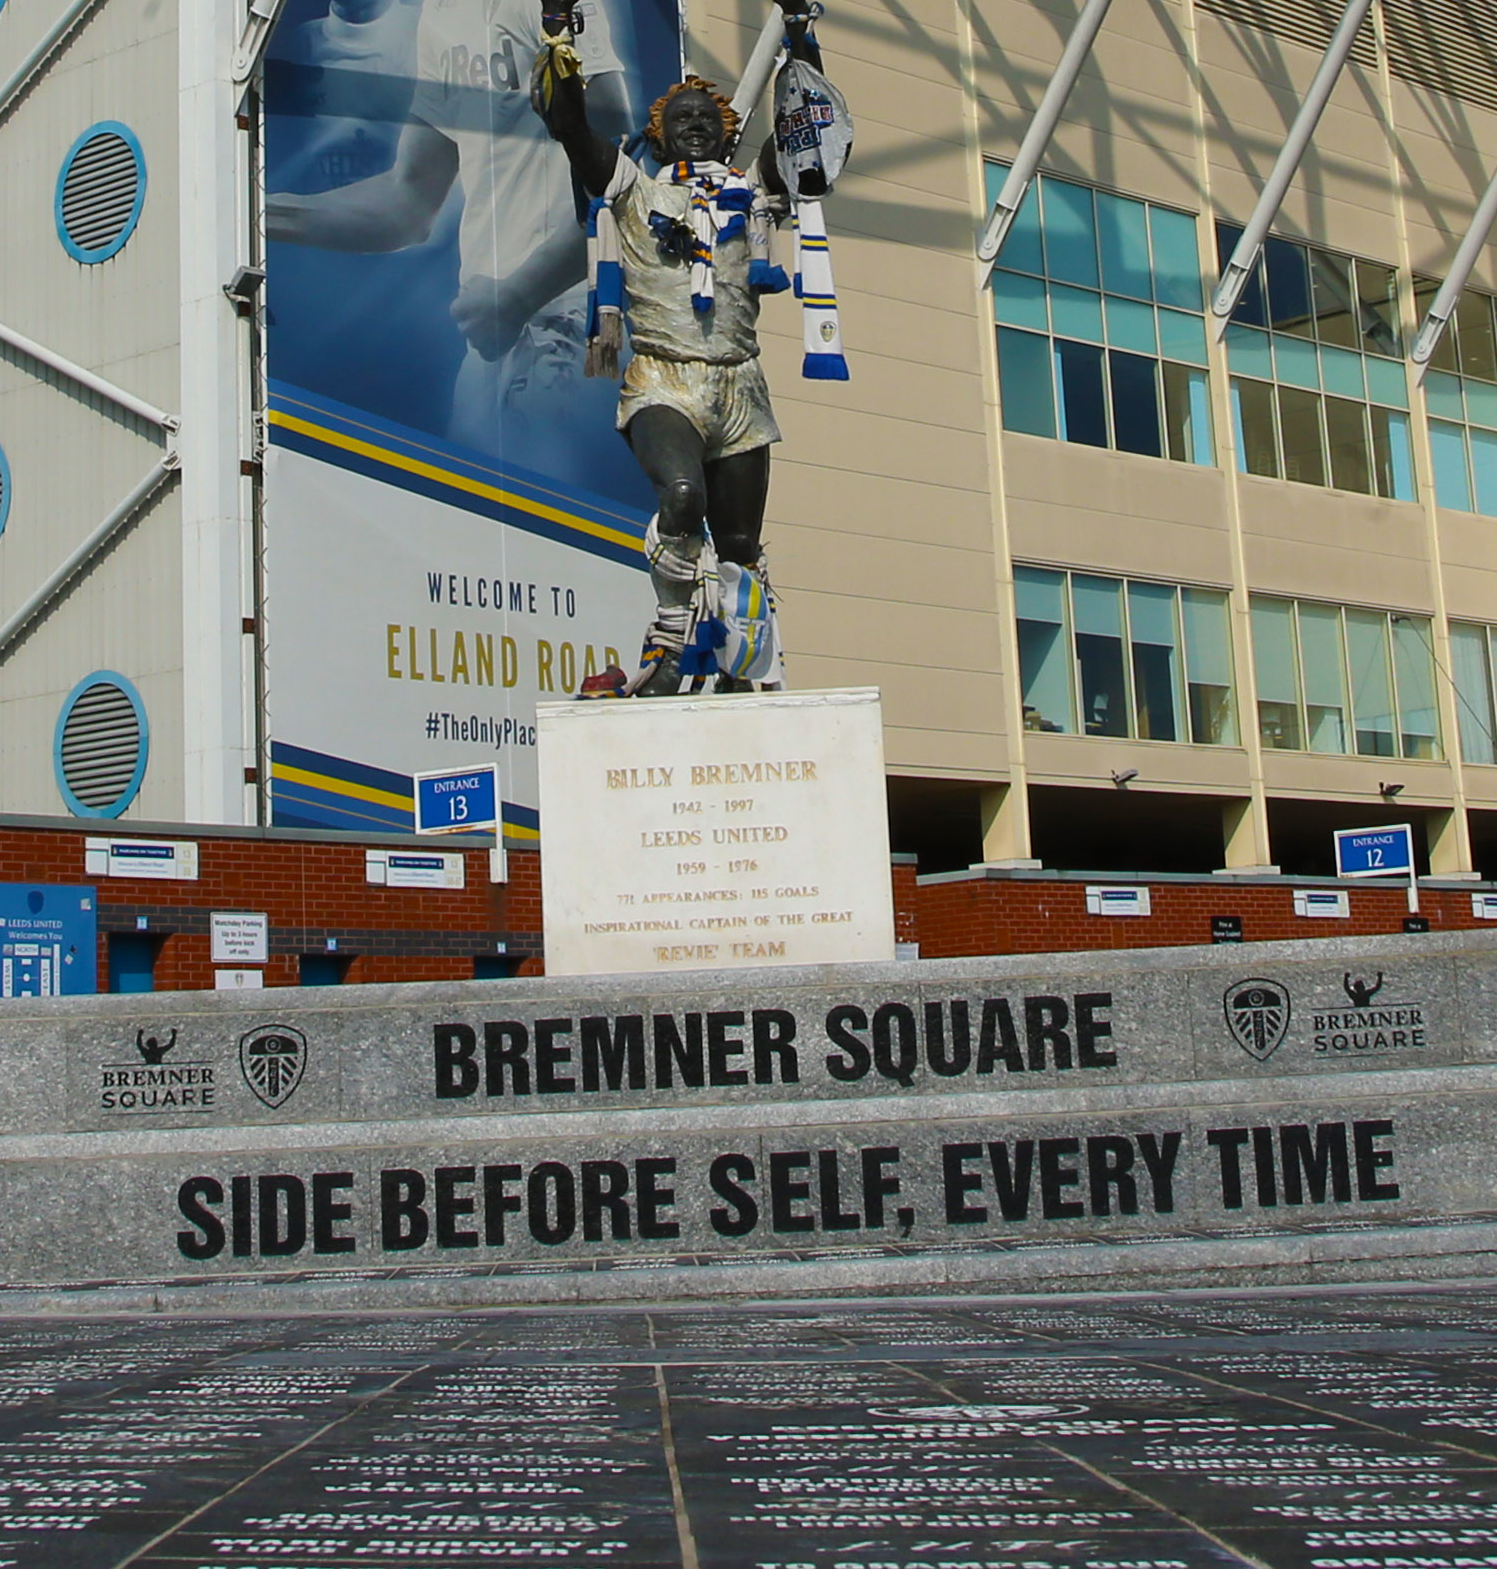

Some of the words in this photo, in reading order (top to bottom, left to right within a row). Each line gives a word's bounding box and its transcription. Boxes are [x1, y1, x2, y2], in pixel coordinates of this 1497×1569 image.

[427, 572, 538, 615] WELCOME
[550, 586, 576, 618] TO
[387, 623, 518, 688] ELLAND
[434, 777, 480, 793] ENTRANCE
[606, 766, 674, 790] BILLY
[691, 760, 818, 786] BREMNER
[449, 795, 468, 820] 13
[672, 801, 702, 815] 1942
[724, 799, 754, 813] 1997
[641, 830, 702, 848] LEEDS
[713, 826, 789, 844] UNITED
[1353, 835, 1395, 847] ENTRANCE
[676, 861, 706, 875] 1959
[728, 859, 758, 873] 1976
[1367, 848, 1384, 867] 12
[616, 894, 634, 905] 771
[642, 890, 743, 904] APPEARANCES:
[774, 886, 819, 898] GOALS
[8, 919, 32, 928] LEEDS
[33, 920, 63, 929] UNITED
[242, 920, 263, 928] Parking
[584, 919, 683, 934] INSPIRATIONAL
[689, 916, 748, 930] CAPTAIN
[754, 915, 771, 926] OF
[777, 913, 805, 925] THE
[811, 911, 853, 924] GREAT
[8, 931, 48, 940] Welcomes
[49, 932, 63, 940] You
[729, 941, 786, 959] TEAM
[1313, 1009, 1424, 1030] BREMNER
[433, 1009, 799, 1099] BREMNER
[825, 992, 1118, 1087] SQUARE
[1313, 1029, 1425, 1050] SQUARE
[102, 1067, 214, 1088] BREMNER
[102, 1088, 215, 1108] SQUARE
[176, 1171, 356, 1260] SIDE
[380, 1157, 681, 1252] BEFORE
[709, 1145, 916, 1238] SELF,
[942, 1132, 1183, 1226] EVERY
[1207, 1119, 1400, 1210] TIME
